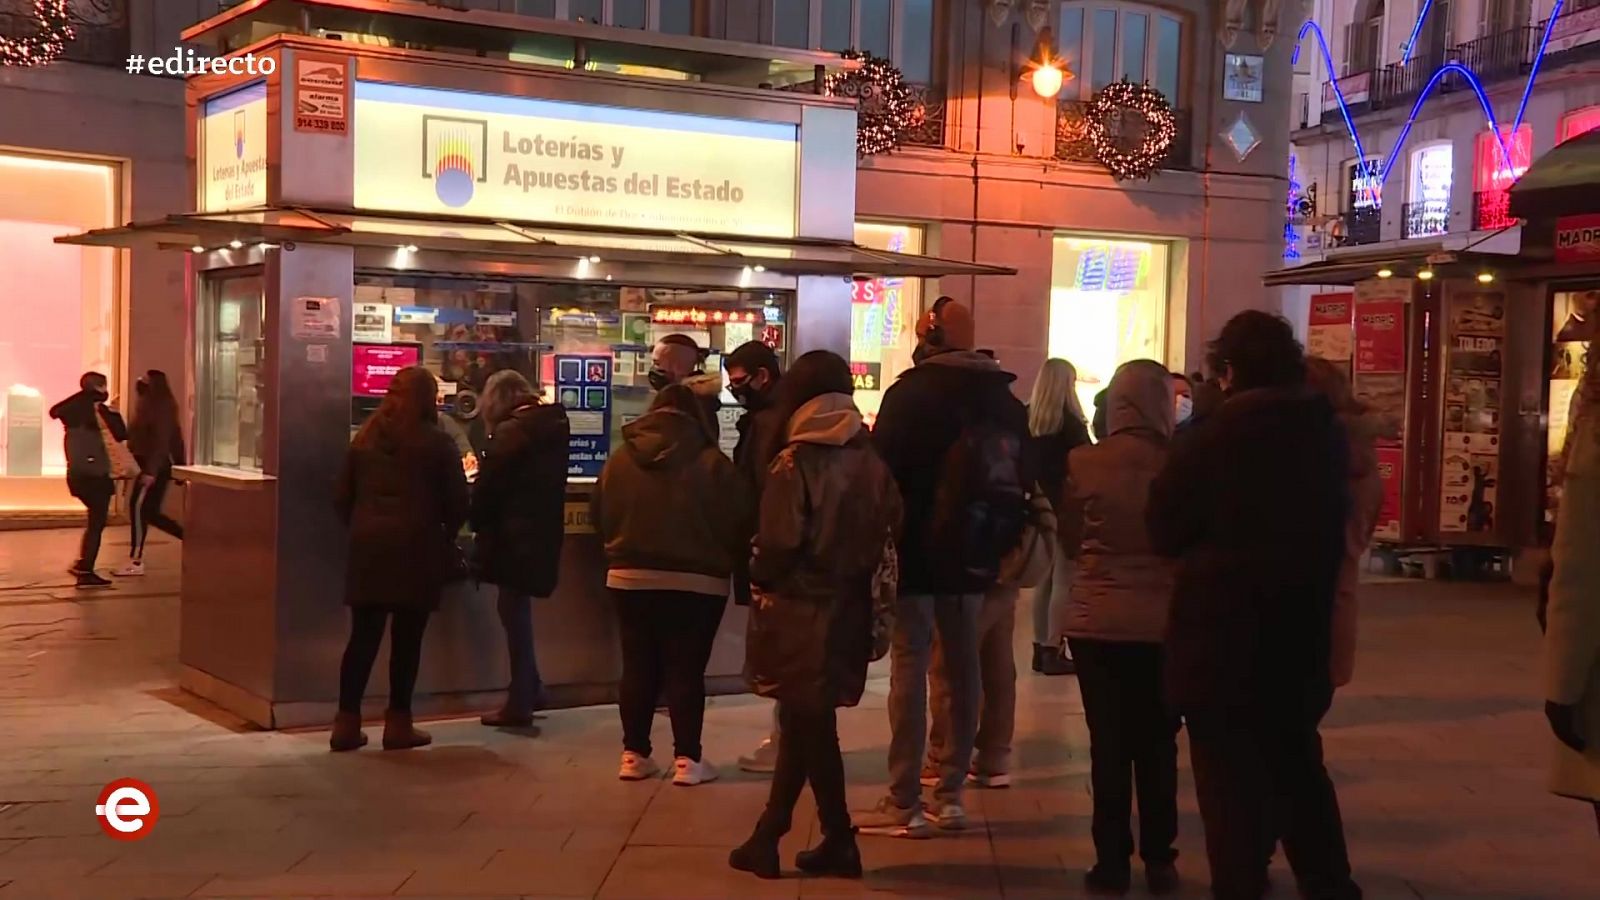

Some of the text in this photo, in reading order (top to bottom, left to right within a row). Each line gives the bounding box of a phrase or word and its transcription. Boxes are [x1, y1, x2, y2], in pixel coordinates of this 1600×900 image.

[503, 131, 624, 168] Loterías y
[503, 163, 744, 203] Apuestas del Estado
[655, 307, 707, 322] suerte
[1458, 336, 1496, 351] TOLEDO
